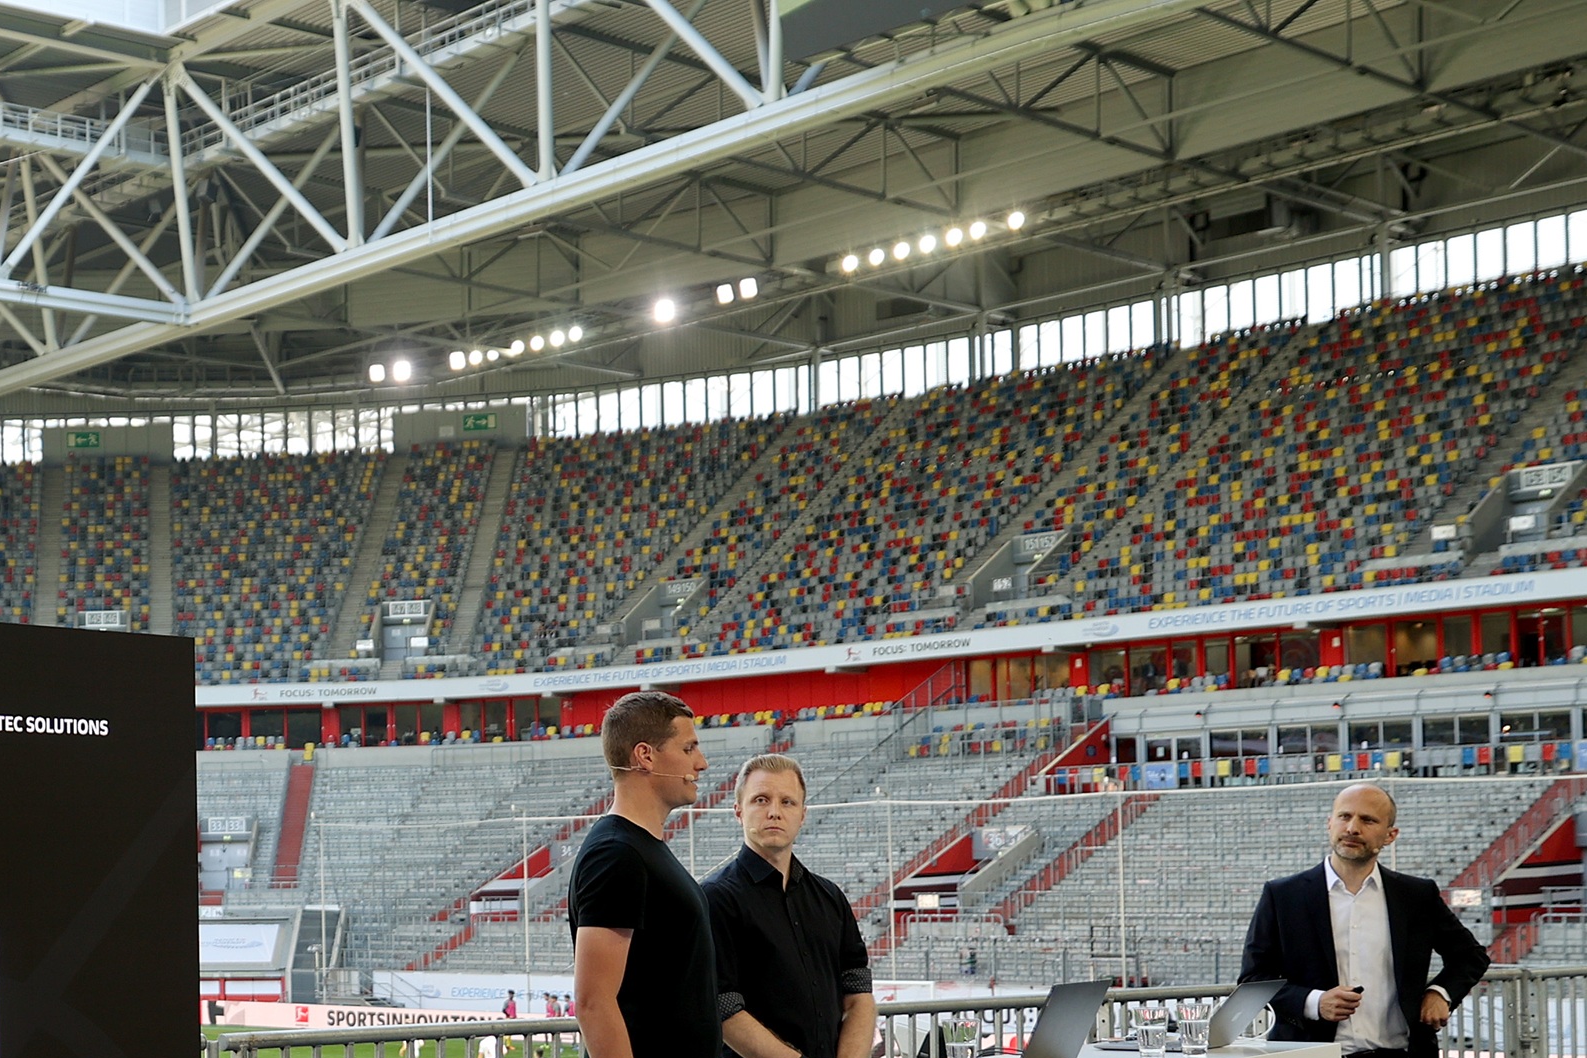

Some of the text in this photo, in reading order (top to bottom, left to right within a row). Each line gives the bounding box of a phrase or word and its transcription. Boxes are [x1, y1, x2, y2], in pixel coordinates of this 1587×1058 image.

[1148, 610, 1226, 630] EXPERIENCE
[1230, 608, 1255, 621] THE
[1258, 602, 1311, 619] FUTURE
[1314, 599, 1334, 614] OF
[1337, 593, 1395, 611] SPORTS
[1405, 587, 1453, 603] MEDIA
[1463, 579, 1535, 598] STADIUM
[872, 637, 971, 657] FOCUS: TOMORROW
[533, 673, 591, 687] EXPERIENCE
[593, 672, 610, 683] THE
[612, 668, 650, 682] FUTURE
[651, 667, 663, 678] OF
[665, 664, 702, 677] SPORTS
[708, 661, 737, 673] MEDIA
[743, 655, 787, 669] STADIUM
[279, 688, 315, 698] FOCUS:
[318, 686, 377, 697] TOMORROW
[26, 716, 108, 736] SOLUTIONS
[451, 986, 505, 998] EXPERIENCE
